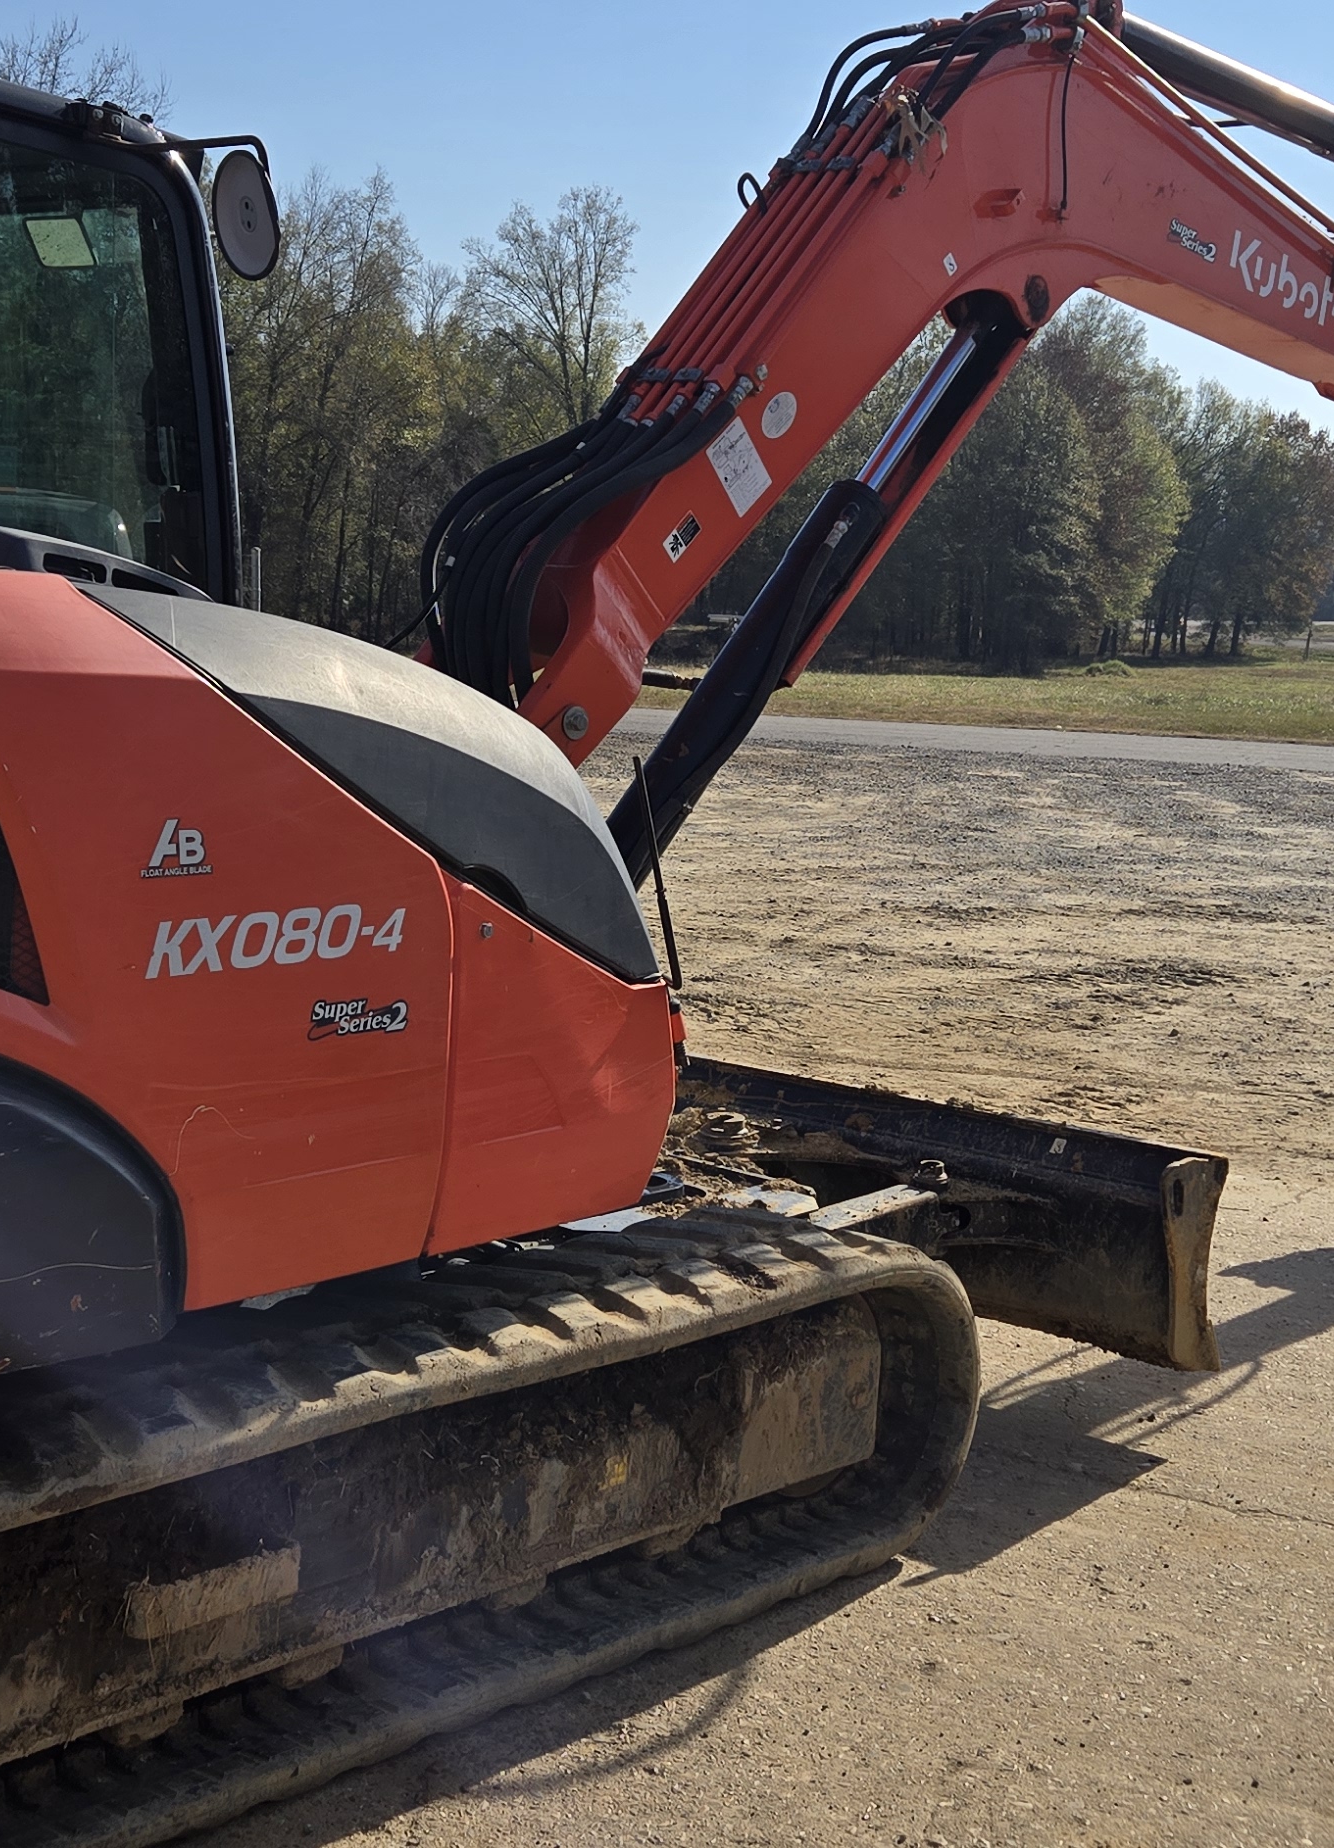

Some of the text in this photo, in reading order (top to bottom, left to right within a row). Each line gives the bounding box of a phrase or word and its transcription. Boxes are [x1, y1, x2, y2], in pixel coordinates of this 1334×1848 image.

[1170, 218, 1197, 239] Super
[148, 818, 205, 867] AB
[140, 864, 212, 878] FLOAT ANGLE BLADE
[145, 904, 406, 979] KX080-4
[312, 1000, 366, 1022] Super
